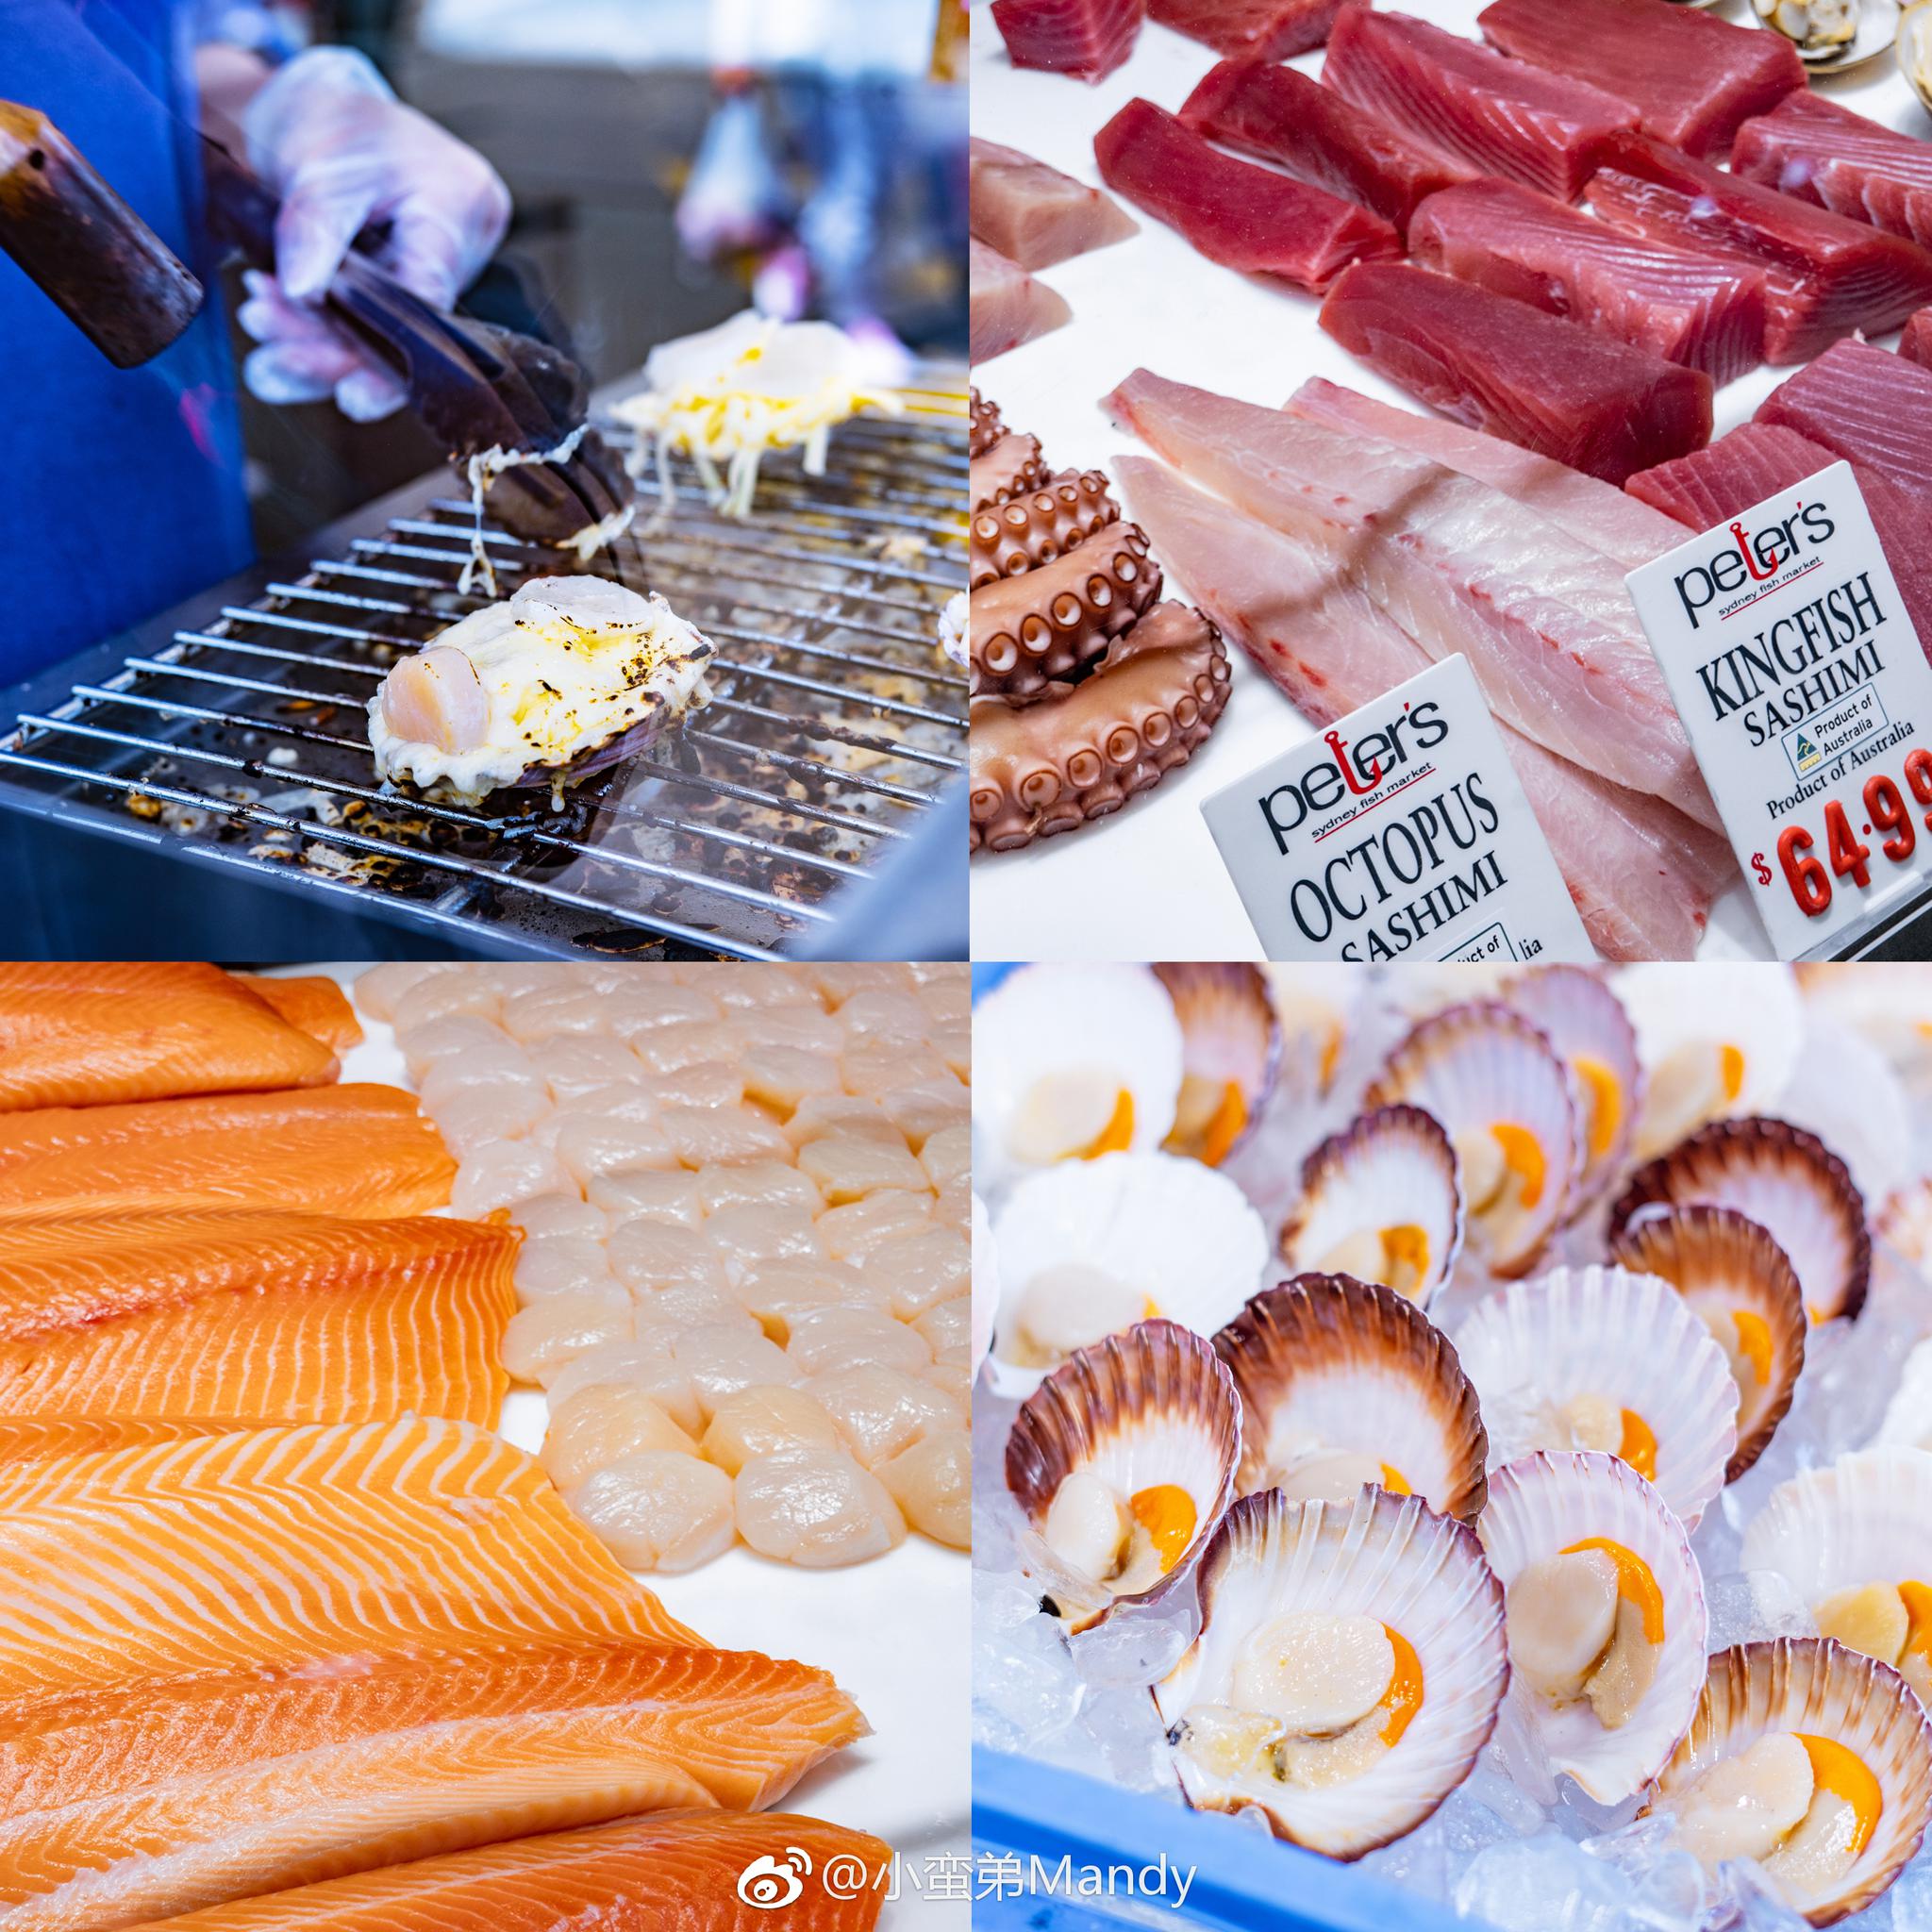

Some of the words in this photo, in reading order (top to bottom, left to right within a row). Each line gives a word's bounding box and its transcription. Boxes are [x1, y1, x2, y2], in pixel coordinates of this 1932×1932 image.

[1674, 501, 1835, 628] peter's
[1718, 591, 1757, 616] sydney
[1759, 578, 1780, 593] fish
[1782, 556, 1821, 580] market
[1695, 572, 1888, 722] KINGFISH
[1744, 639, 1886, 748] SASHIMI
[1814, 703, 1859, 739] Product
[1860, 693, 1874, 710] of
[1823, 717, 1874, 757] Australia
[1258, 701, 1449, 856] peter's
[1311, 807, 1357, 838] sydney
[1359, 791, 1384, 808] fish
[1387, 762, 1433, 793] market
[1766, 774, 1828, 821] Product
[1830, 756, 1847, 781] of
[1851, 721, 1916, 771] Australia
[1290, 772, 1499, 943] OCTOPUS
[1487, 934, 1500, 953] of
